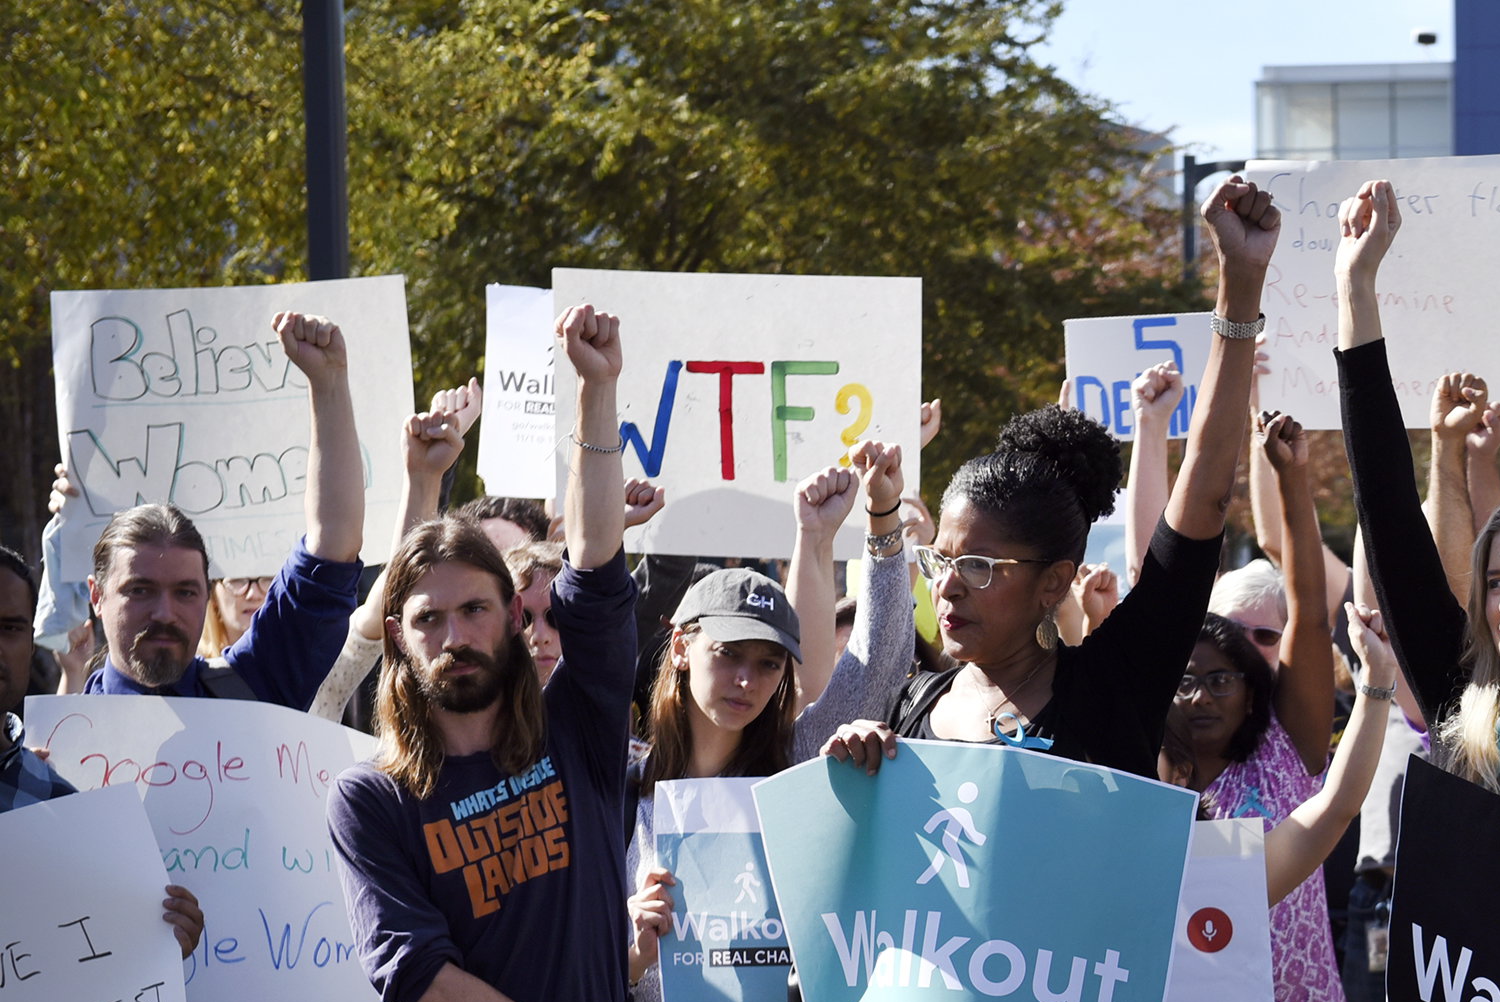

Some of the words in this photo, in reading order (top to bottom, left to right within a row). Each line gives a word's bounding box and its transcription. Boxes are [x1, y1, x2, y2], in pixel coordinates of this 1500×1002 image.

[1132, 316, 1184, 377] 5
[450, 779, 509, 821] WHAT'S
[423, 780, 569, 875] OUTSIDE
[462, 826, 570, 919] LANDS
[57, 916, 113, 963] I
[673, 951, 705, 966] FOR
[712, 949, 752, 965] REAL
